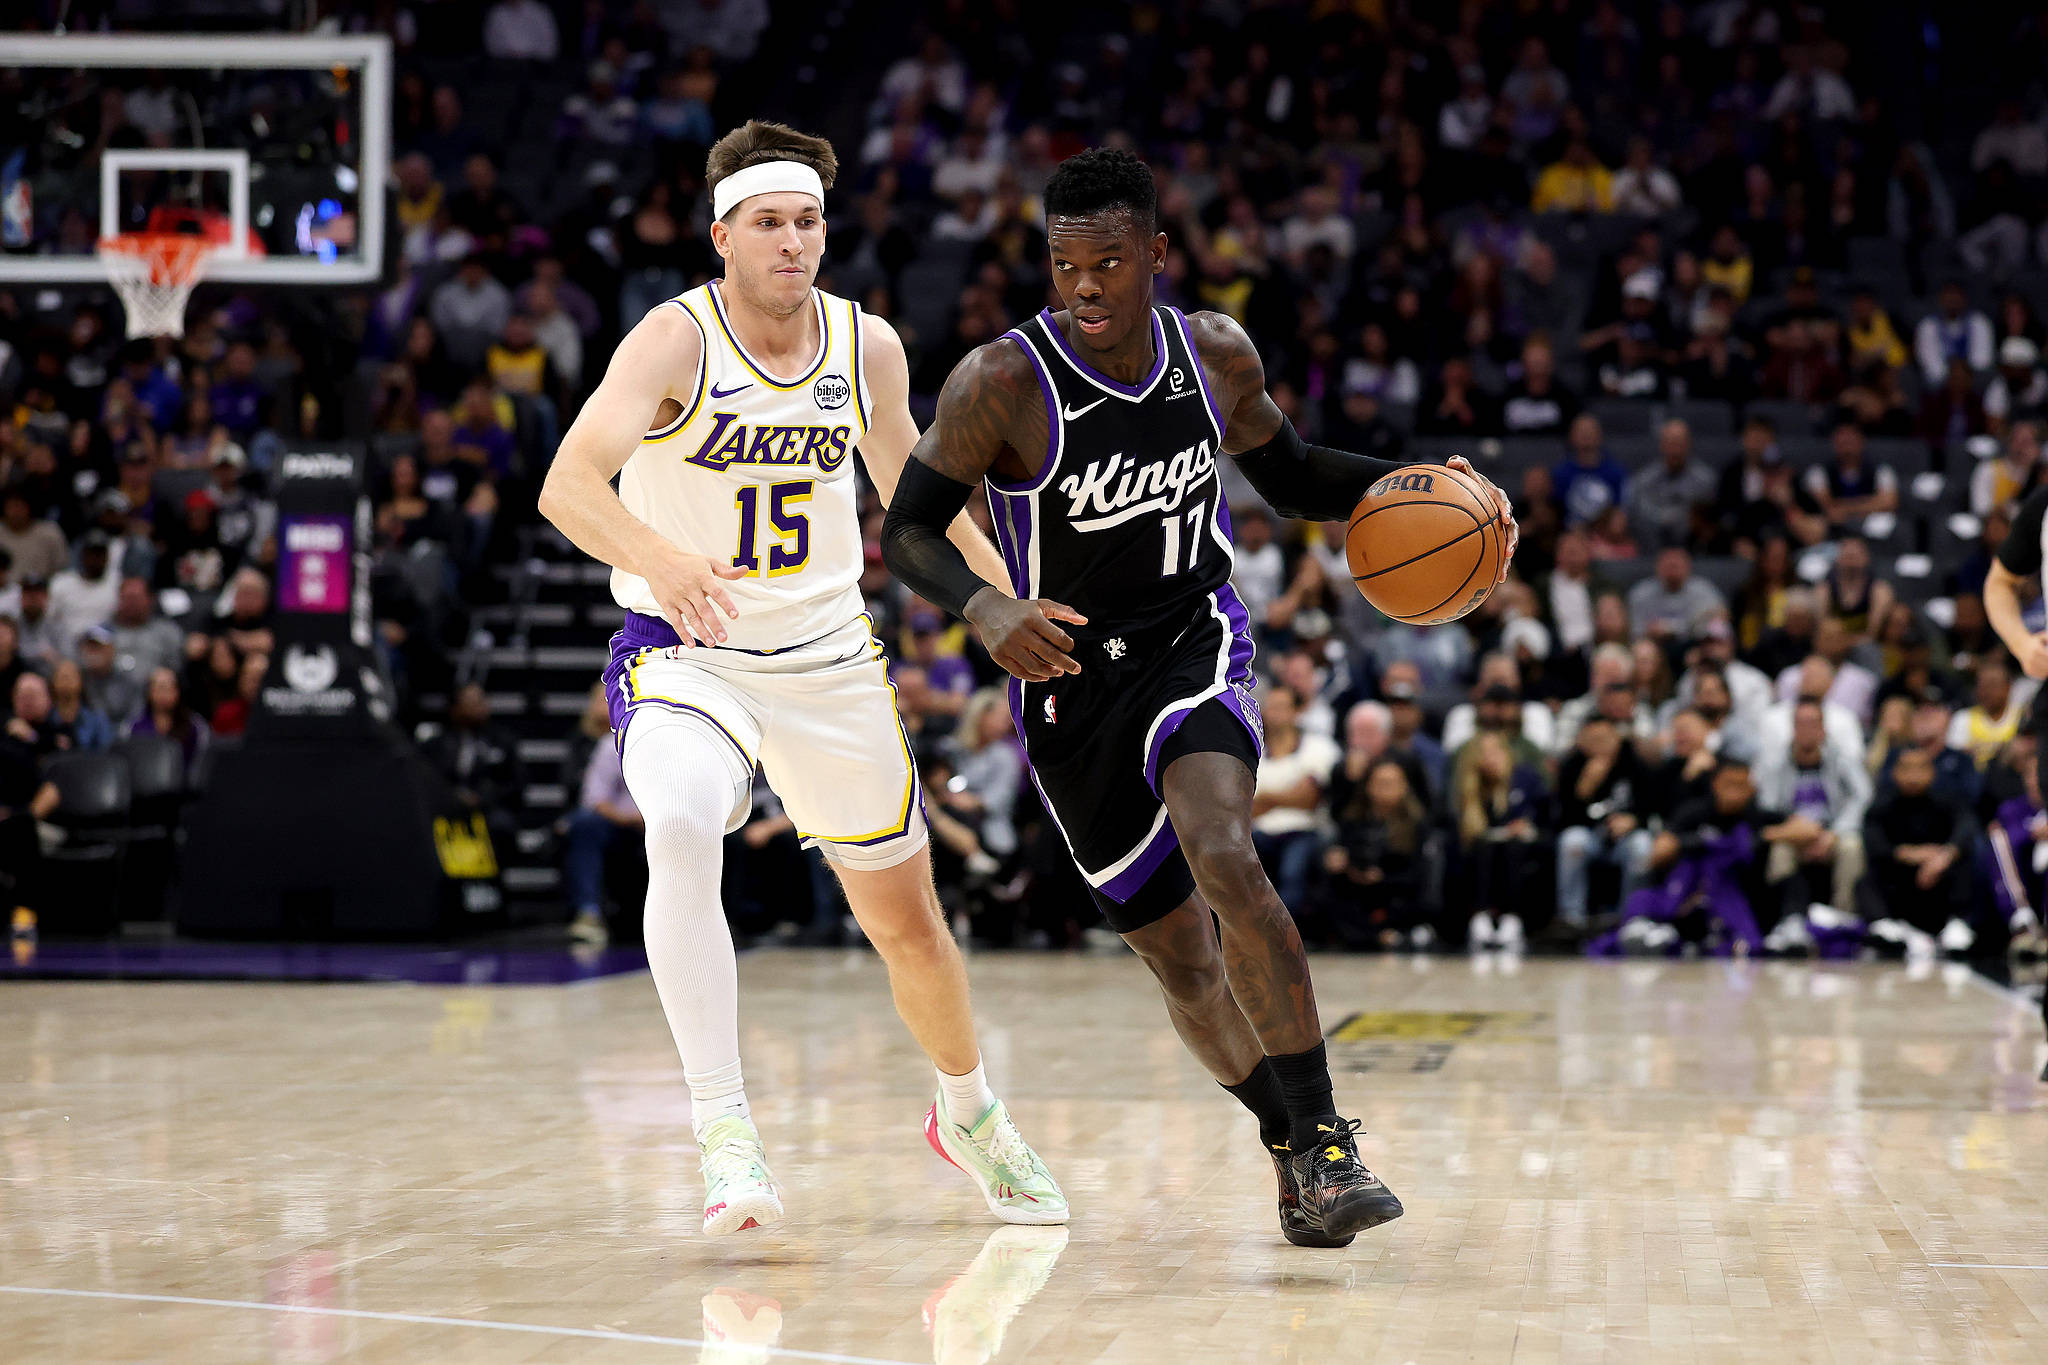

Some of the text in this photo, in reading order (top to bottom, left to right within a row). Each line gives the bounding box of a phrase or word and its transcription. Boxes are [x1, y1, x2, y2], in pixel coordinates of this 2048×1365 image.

[816, 384, 848, 400] bibigo
[684, 411, 850, 473] LAKERS
[1058, 438, 1215, 533] Kings
[730, 479, 815, 578] 15
[1161, 498, 1207, 577] 17
